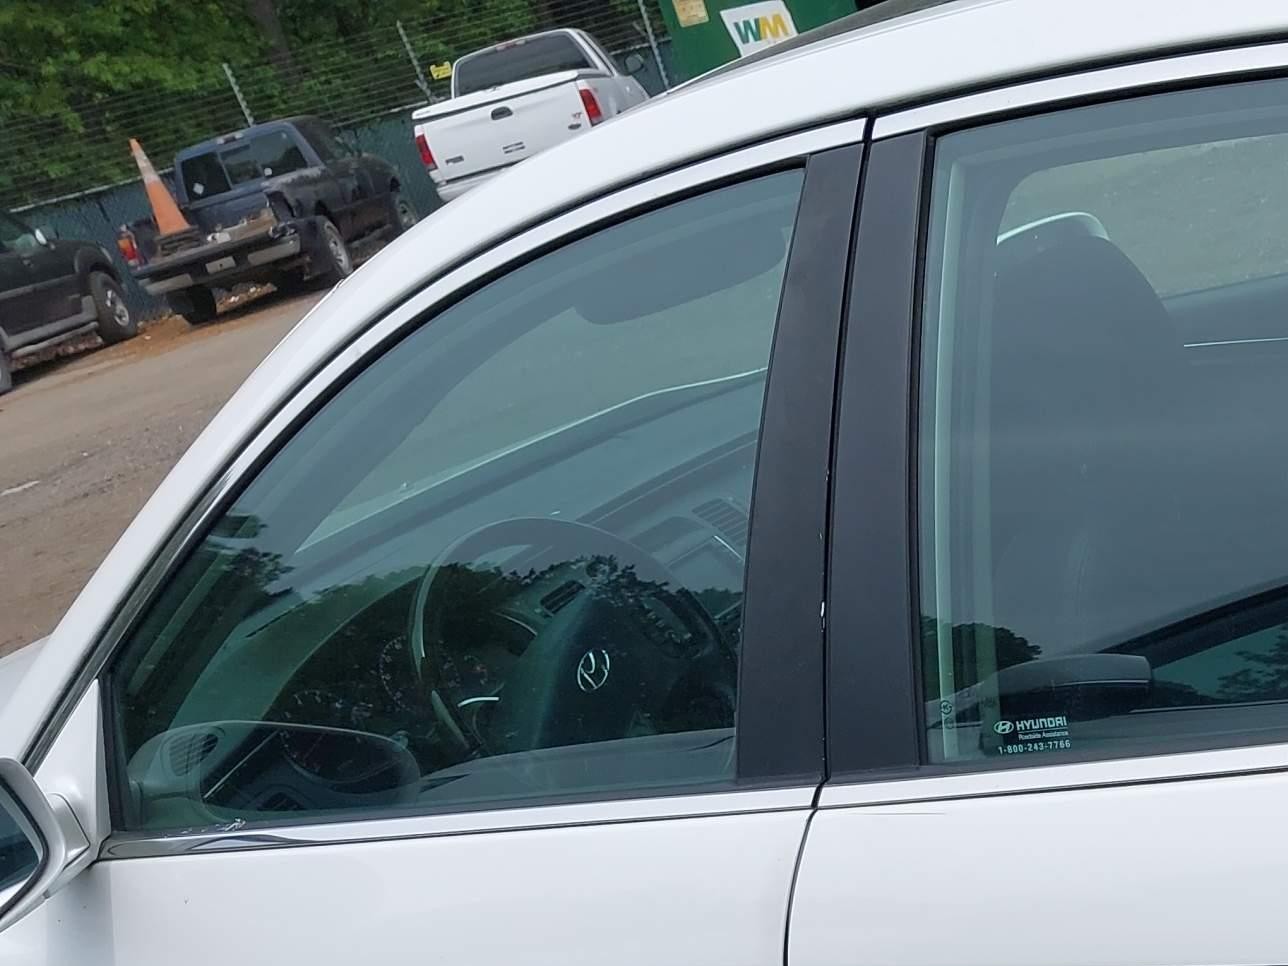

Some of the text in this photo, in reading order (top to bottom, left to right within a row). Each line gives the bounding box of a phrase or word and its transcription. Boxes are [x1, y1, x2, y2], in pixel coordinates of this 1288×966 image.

[733, 13, 789, 45] WM
[1016, 716, 1067, 731] HYUNDAI
[998, 740, 1071, 755] 1-800-243-7766
